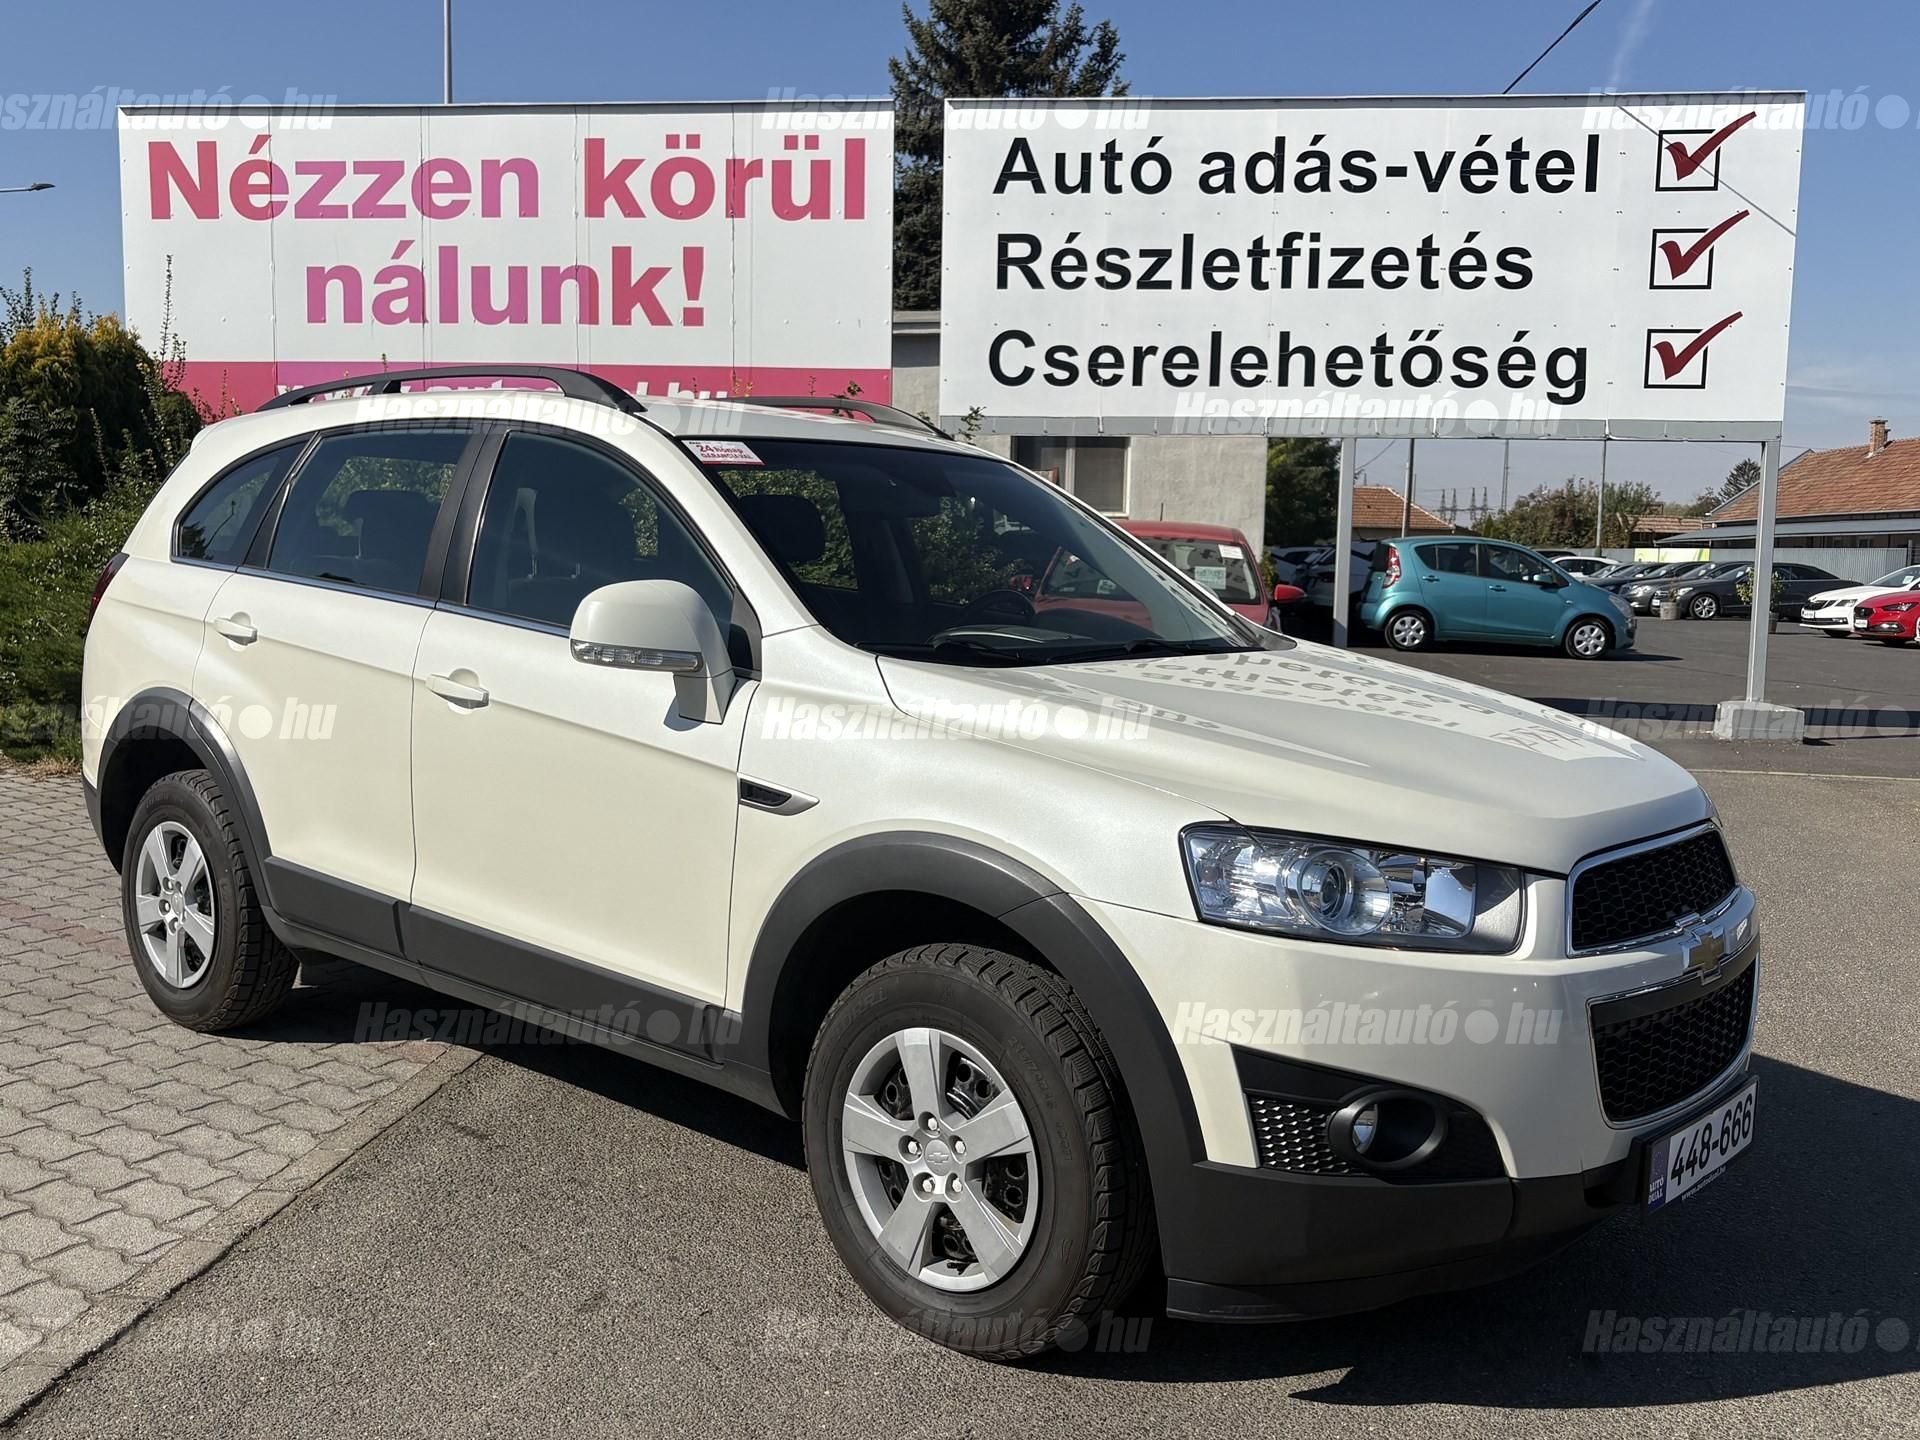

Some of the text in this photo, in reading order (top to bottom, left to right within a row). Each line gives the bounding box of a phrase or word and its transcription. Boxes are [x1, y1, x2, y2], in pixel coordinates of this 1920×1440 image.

[148, 134, 867, 222] Nézzen körül
[993, 134, 1600, 196] Autó adás-vétel
[306, 240, 706, 327] nálunk!
[997, 231, 1534, 292] Részletfizetés
[989, 329, 1588, 406] Cserelehetőség
[1670, 1093, 1753, 1187] 448-666
